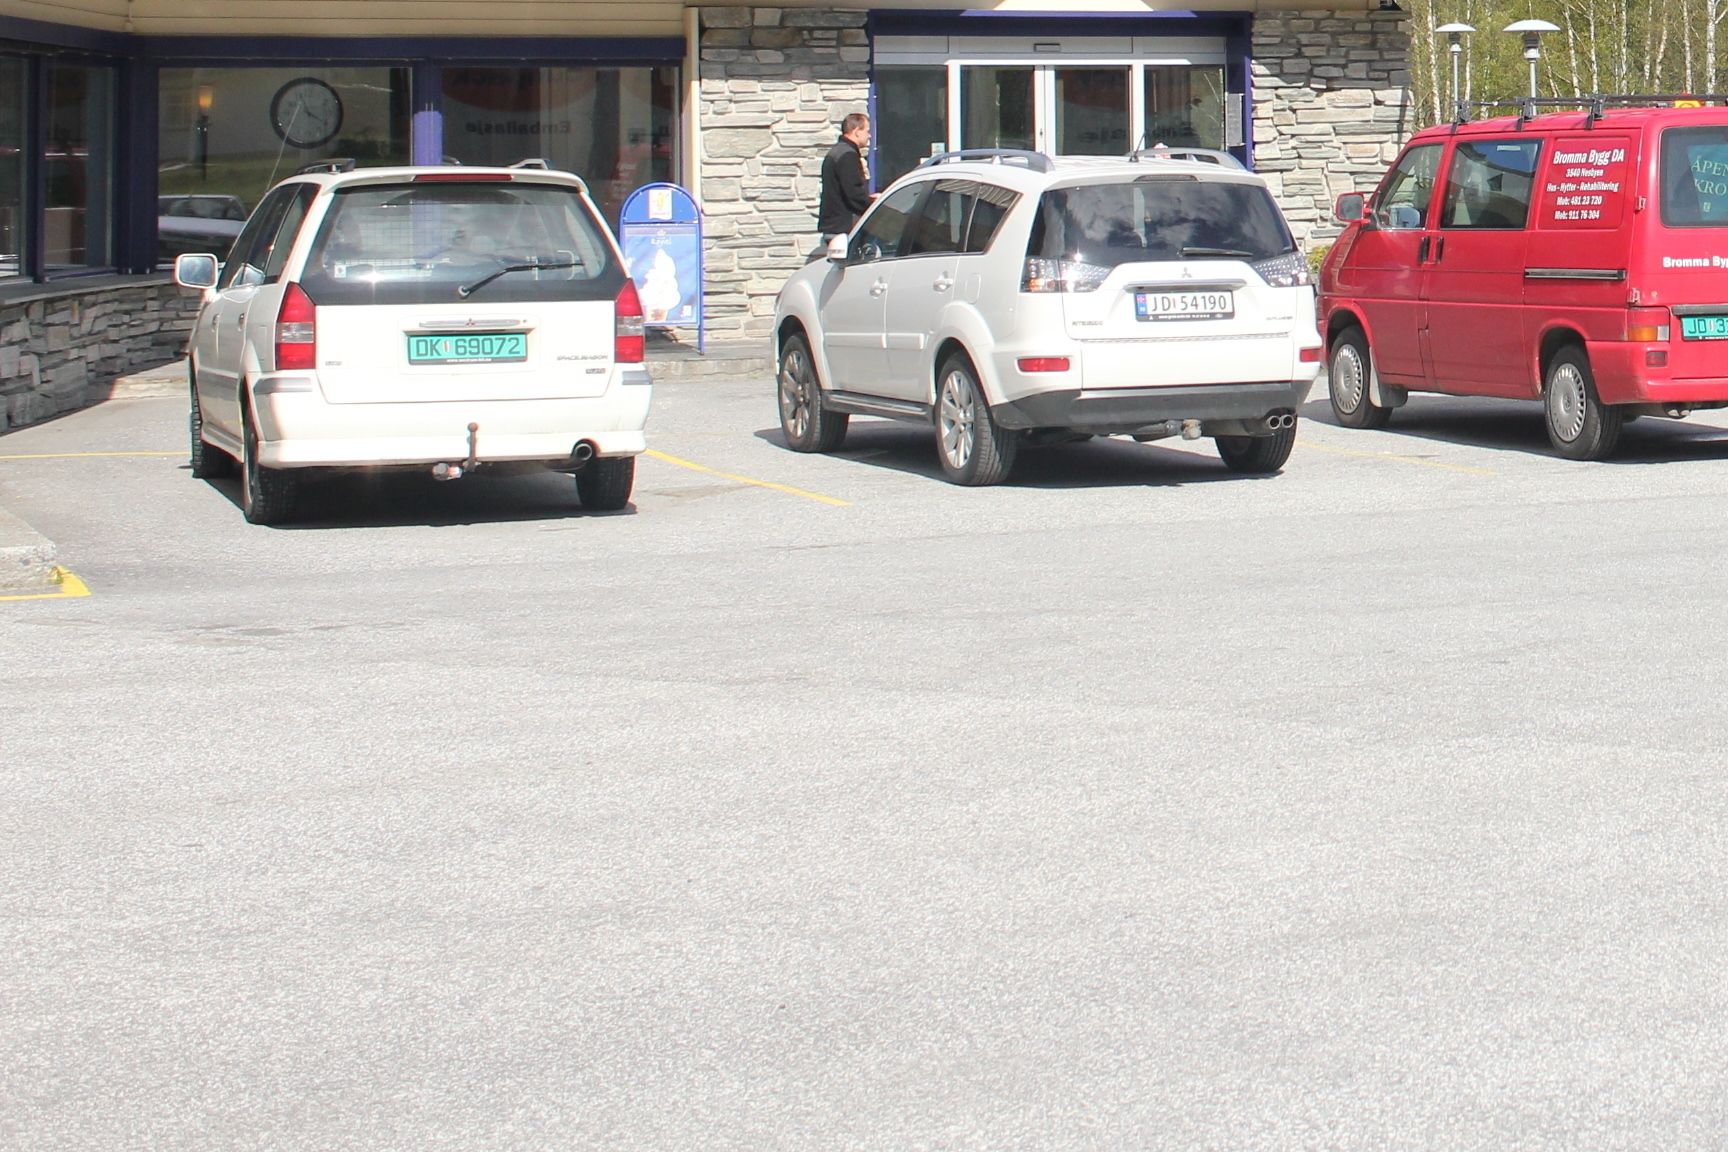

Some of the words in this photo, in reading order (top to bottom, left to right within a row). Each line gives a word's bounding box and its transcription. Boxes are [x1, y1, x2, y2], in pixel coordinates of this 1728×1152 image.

[1553, 151, 1588, 164] Bromma
[1588, 149, 1611, 166] Bygg
[1611, 149, 1625, 162] DA
[1694, 179, 1727, 196] KRO
[1663, 256, 1710, 268] Bromma
[1152, 296, 1171, 312] JD
[1180, 295, 1226, 311] 54190
[1688, 319, 1707, 334] JD
[416, 339, 442, 356] DK
[454, 337, 520, 356] 69072
